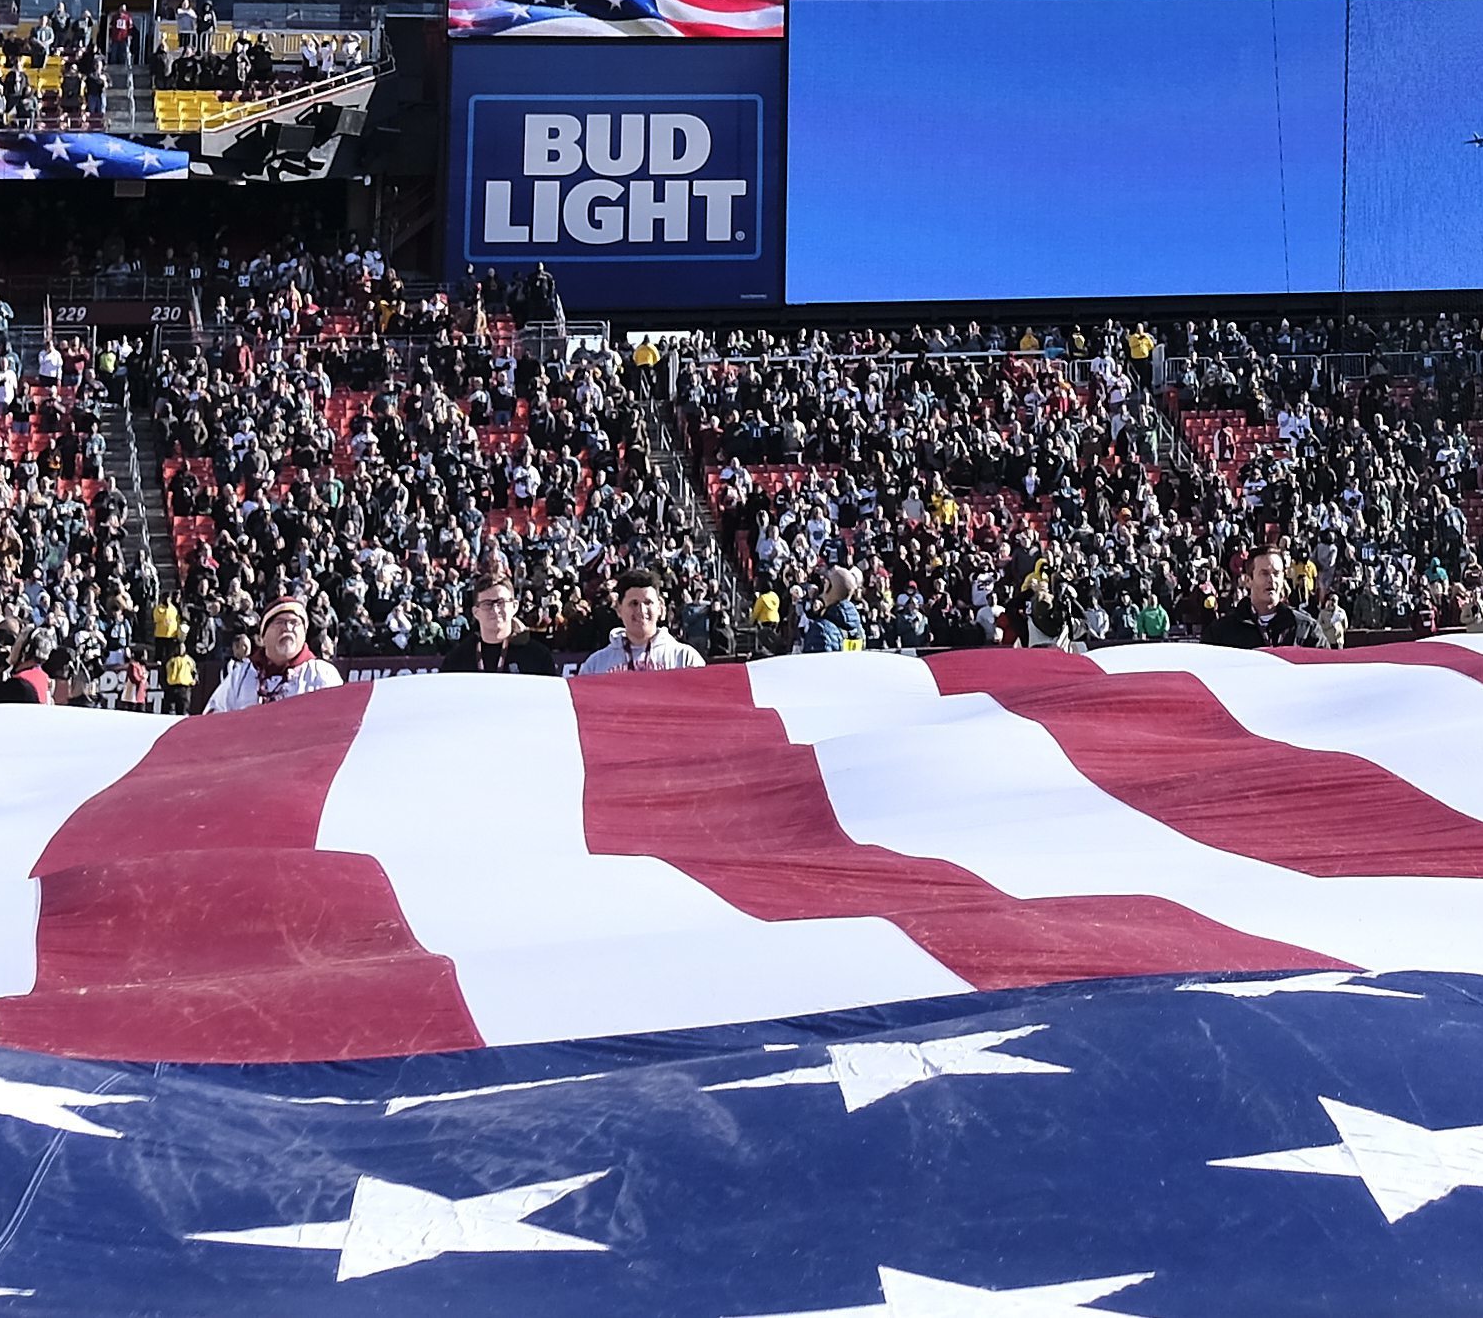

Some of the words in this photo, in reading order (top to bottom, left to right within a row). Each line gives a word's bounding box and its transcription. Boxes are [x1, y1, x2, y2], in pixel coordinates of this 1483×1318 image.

[524, 114, 711, 176] BUD
[484, 179, 746, 244] LIGHT
[56, 307, 87, 322] 229
[151, 306, 181, 321] 230
